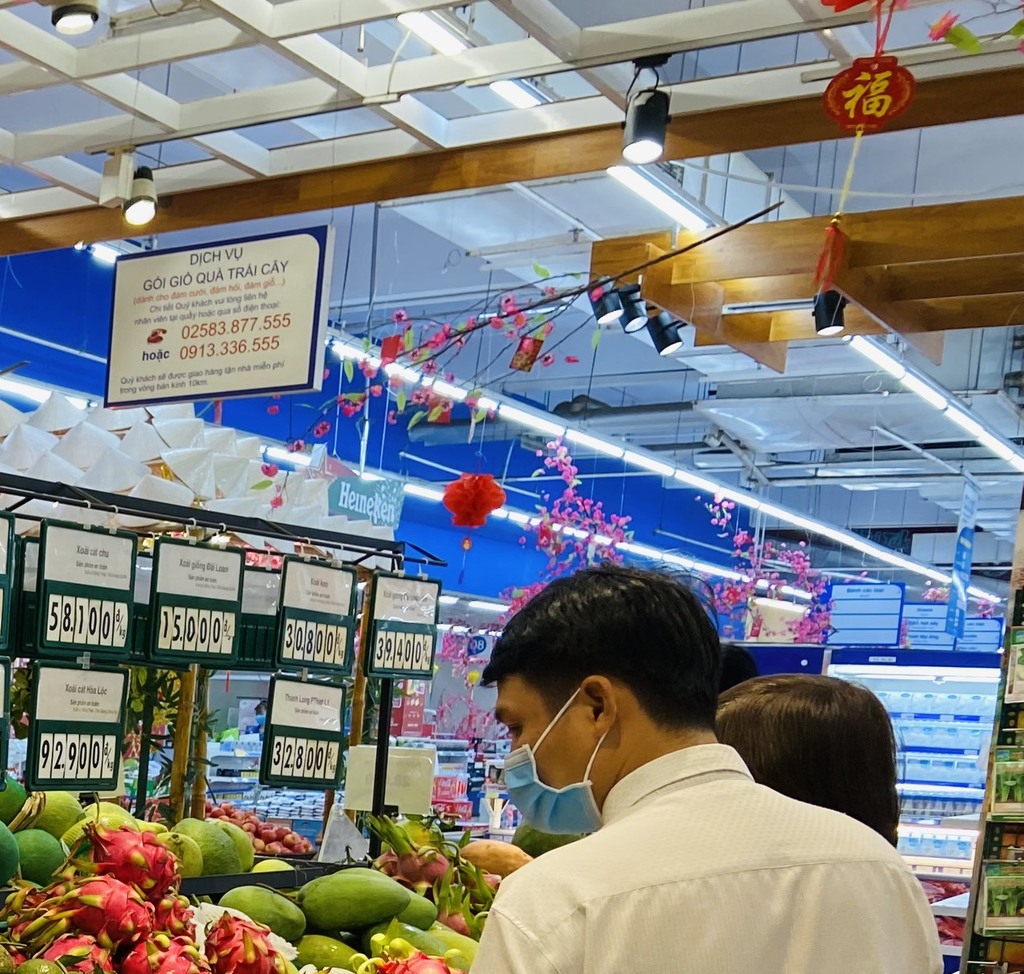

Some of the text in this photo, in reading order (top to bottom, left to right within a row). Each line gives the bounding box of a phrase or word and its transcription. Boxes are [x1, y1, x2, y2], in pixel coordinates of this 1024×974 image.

[842, 71, 892, 118] 福
[190, 248, 243, 266] DỊCH VỤ
[143, 276, 165, 292] GÓI
[196, 267, 224, 284] QUÀ
[228, 264, 257, 280] TRÁI
[261, 260, 288, 275] CÂY
[155, 293, 169, 301] cho
[191, 299, 212, 308] khách
[181, 313, 291, 339] 02583.877.555
[142, 335, 280, 362] hoặc 0913.336.555
[136, 375, 157, 383] khách
[188, 369, 203, 379] giao
[205, 367, 223, 377] hàng
[119, 387, 137, 395] trong
[338, 481, 395, 524] Heineken
[49, 602, 111, 639] 58.100
[163, 611, 221, 644] 15.000
[286, 624, 334, 656] 30.800
[377, 638, 422, 664] 39.400
[41, 740, 100, 771] 92.900
[273, 741, 324, 771] 32.800
